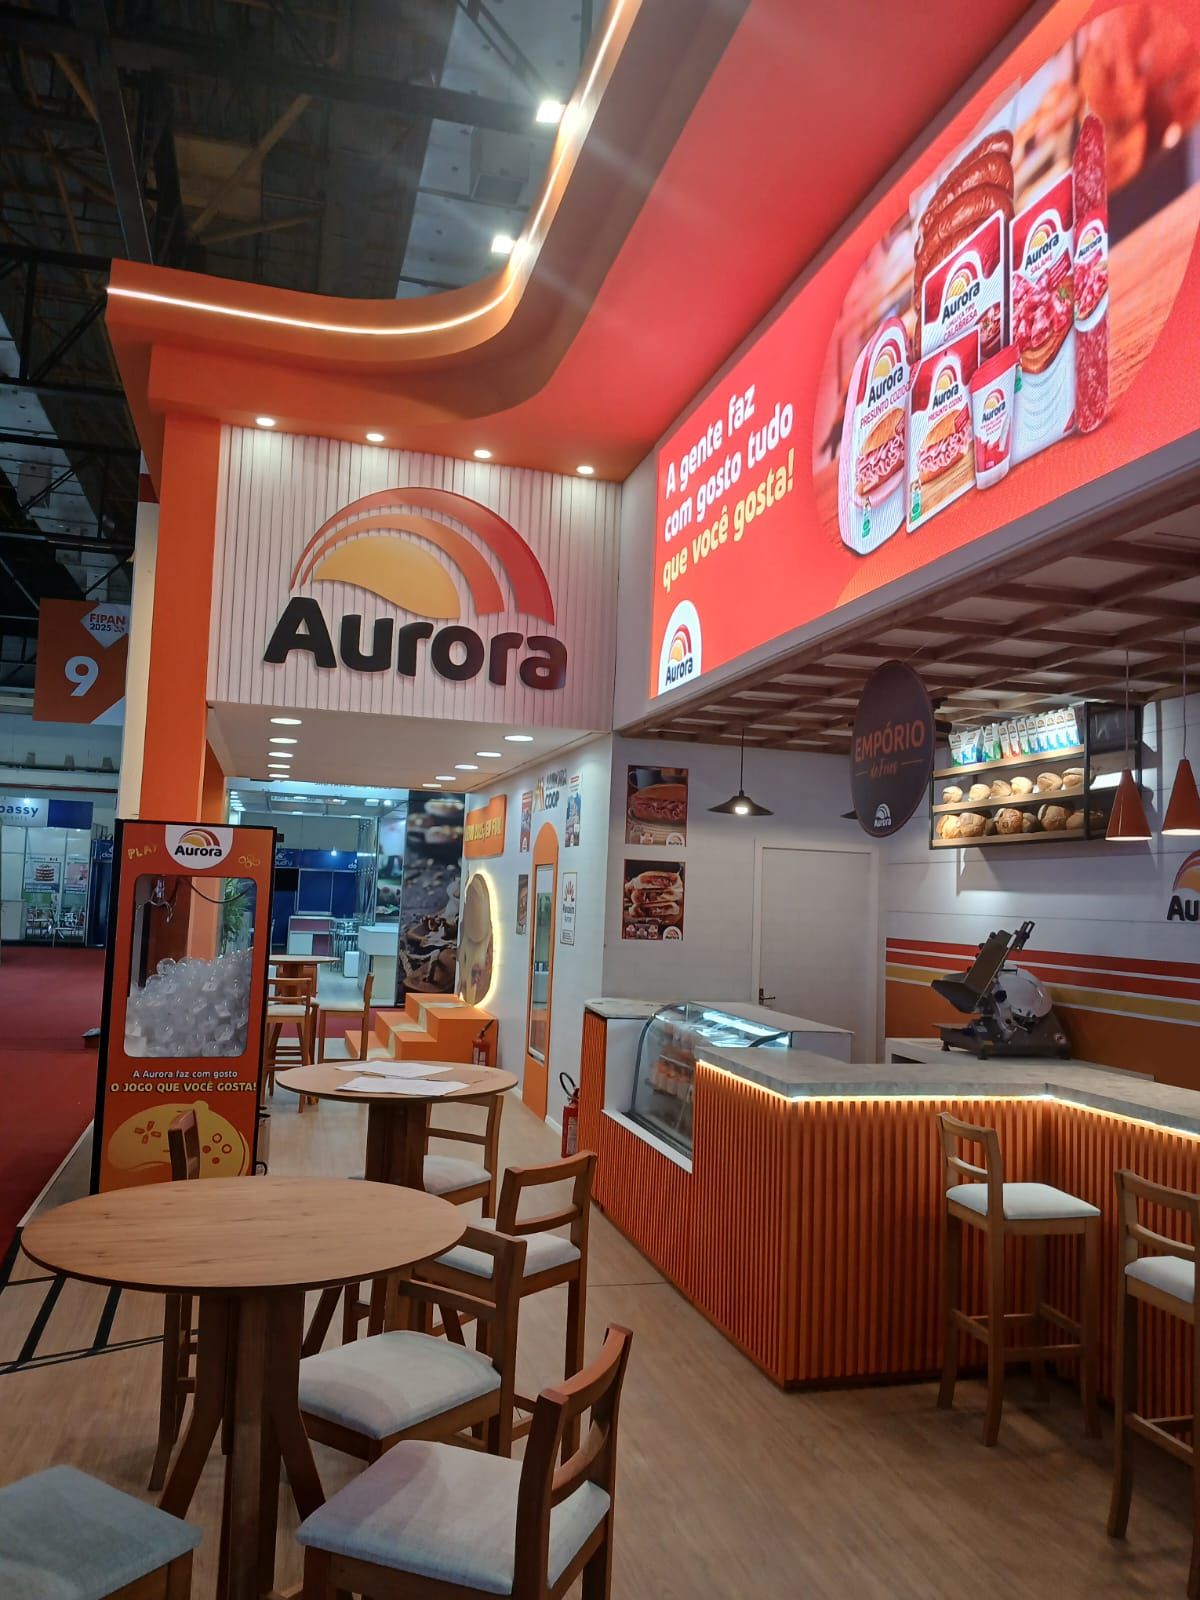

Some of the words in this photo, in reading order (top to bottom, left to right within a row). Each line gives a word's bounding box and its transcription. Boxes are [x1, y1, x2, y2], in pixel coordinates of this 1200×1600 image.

[1025, 233, 1060, 271] Aurora
[1078, 235, 1102, 258] Aurora
[1031, 252, 1053, 276] SALAME
[942, 281, 980, 325] Aurora
[868, 366, 904, 408] Aurora
[932, 383, 959, 411] Aurora
[860, 397, 889, 429] PRESUNTO
[928, 405, 949, 422] PRESUNTO
[982, 400, 1006, 423] Aurora
[666, 462, 676, 499] A
[679, 419, 723, 492] gente
[727, 384, 756, 437] faz
[664, 497, 693, 542] com
[696, 451, 742, 523] gosto
[747, 402, 794, 470] tudo
[662, 547, 688, 592] que
[692, 505, 729, 565] você
[733, 448, 795, 541] gosta!
[89, 613, 126, 625] FIPAN
[89, 623, 112, 632] 2025
[263, 596, 568, 691] Aurora
[64, 655, 99, 696] 9
[665, 656, 694, 687] Aurora
[855, 719, 926, 762] EMPÓRIO
[174, 845, 223, 857] Aurora
[111, 1083, 119, 1092] O
[123, 1083, 153, 1092] JOGO
[156, 1083, 180, 1093] QUE
[217, 1082, 257, 1092] GOSTA!
[133, 1070, 140, 1078] A
[143, 1070, 174, 1078] Aurora
[176, 1070, 189, 1078] faz
[213, 1071, 238, 1079] gosto
